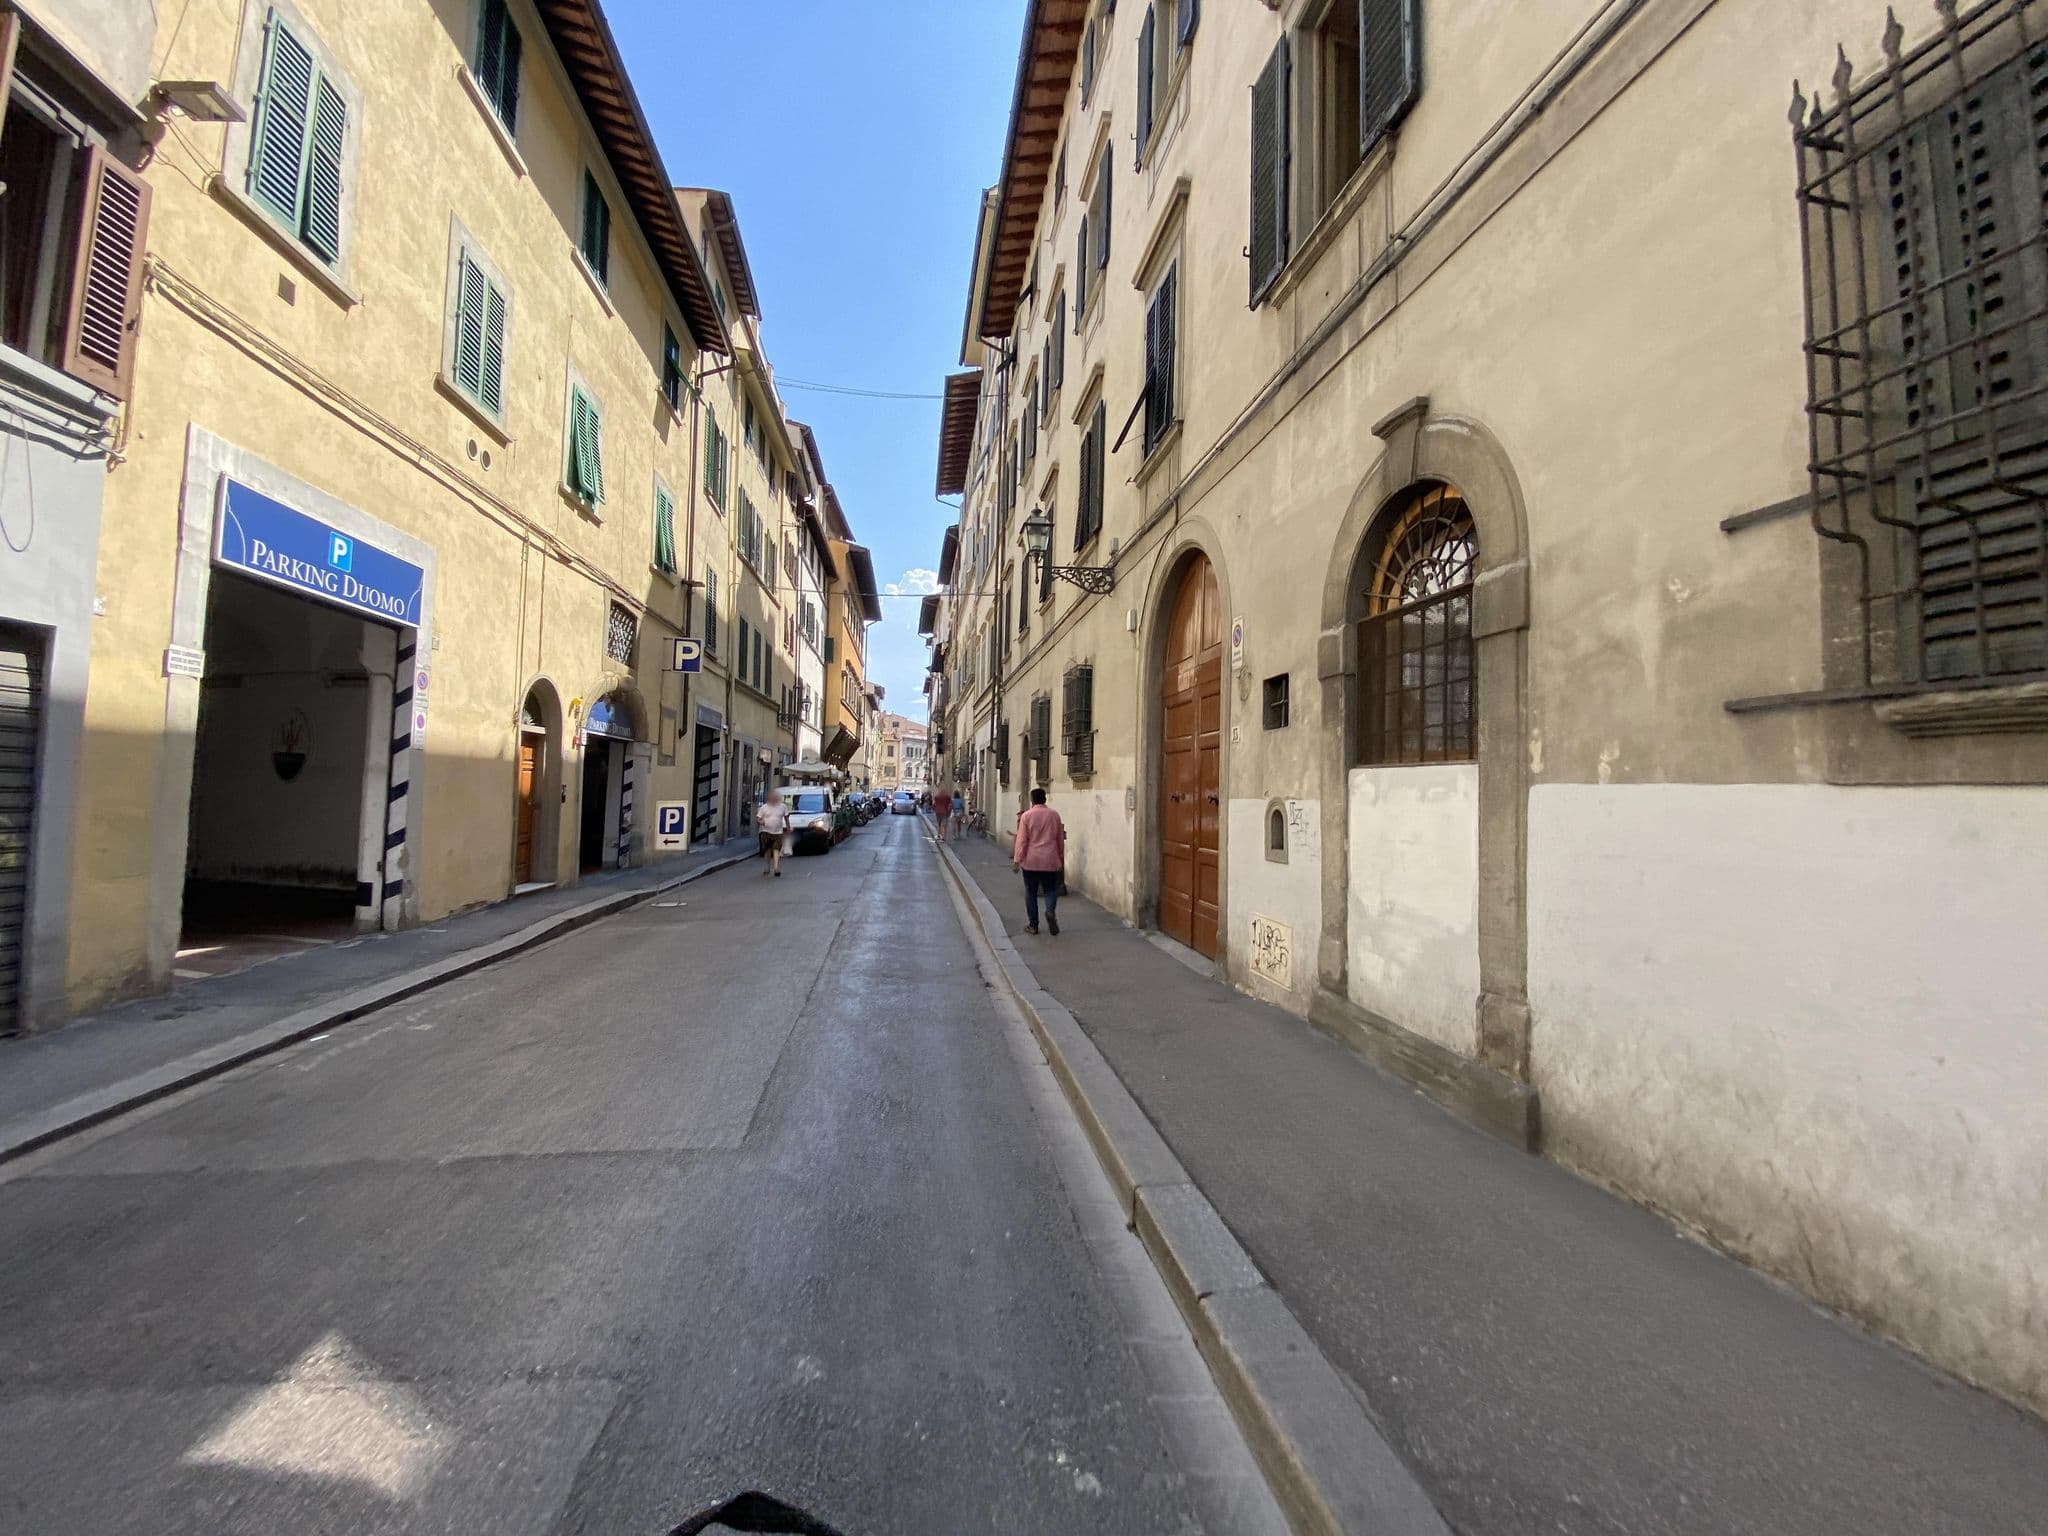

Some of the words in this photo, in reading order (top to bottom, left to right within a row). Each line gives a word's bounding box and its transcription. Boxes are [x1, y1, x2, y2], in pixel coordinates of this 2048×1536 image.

[333, 537, 348, 564] P
[251, 538, 338, 591] PARKING
[342, 574, 405, 616] DUOMO
[675, 640, 700, 670] P
[665, 808, 680, 833] P
